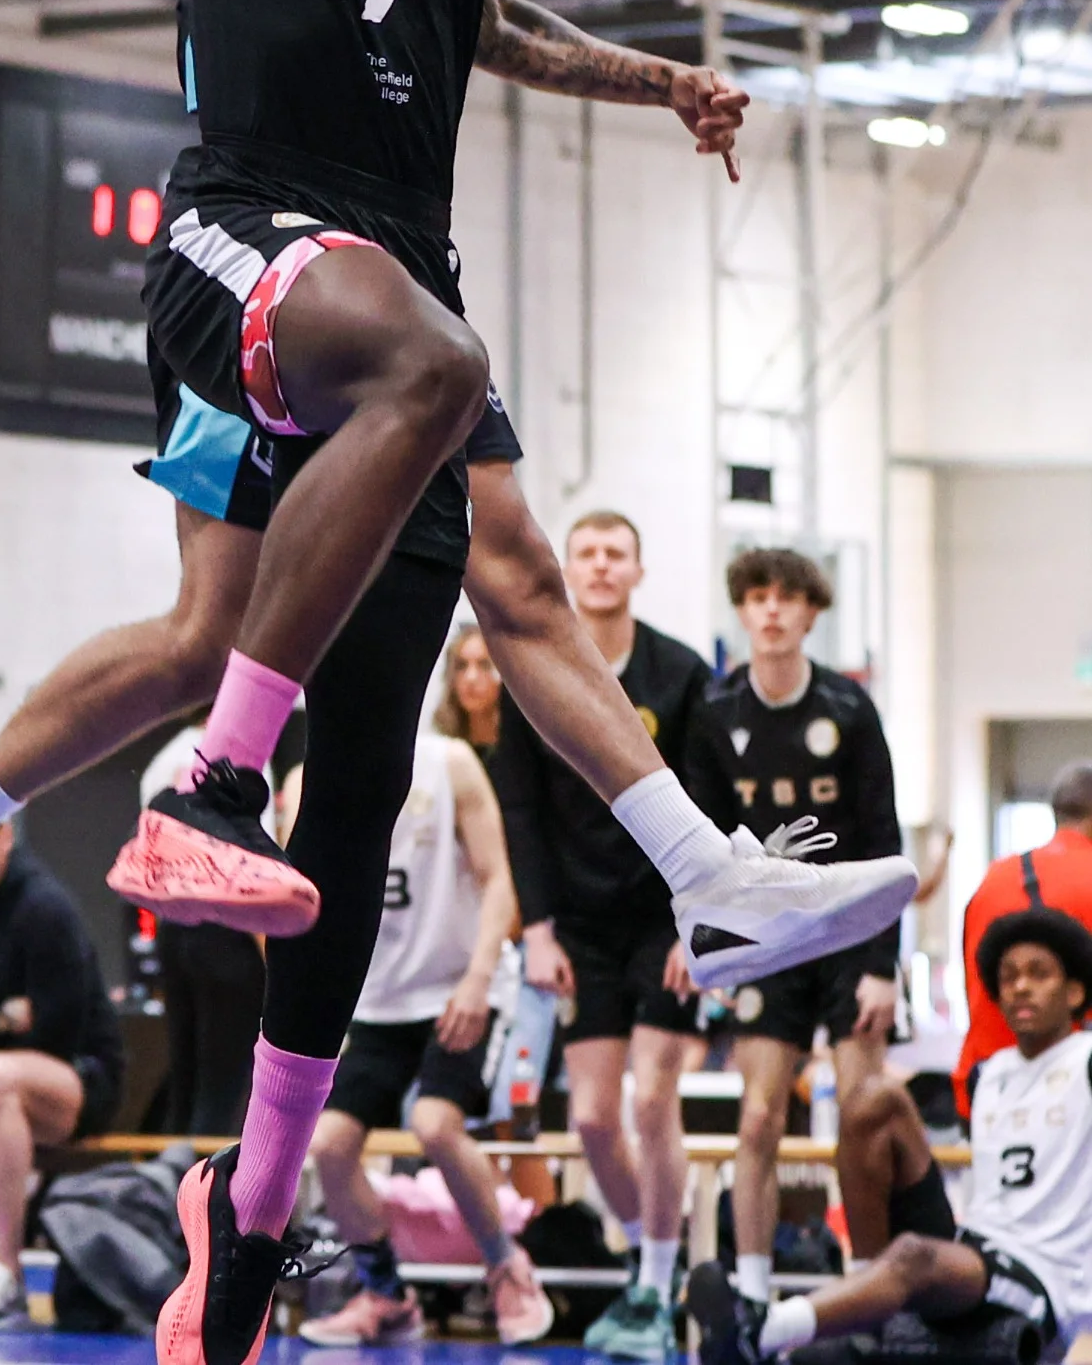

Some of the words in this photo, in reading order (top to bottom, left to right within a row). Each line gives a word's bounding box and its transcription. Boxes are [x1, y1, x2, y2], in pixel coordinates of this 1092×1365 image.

[366, 52, 387, 67] he
[373, 70, 413, 88] effield
[380, 86, 410, 105] llege
[733, 775, 840, 808] TSC
[1000, 1145, 1036, 1189] 3
